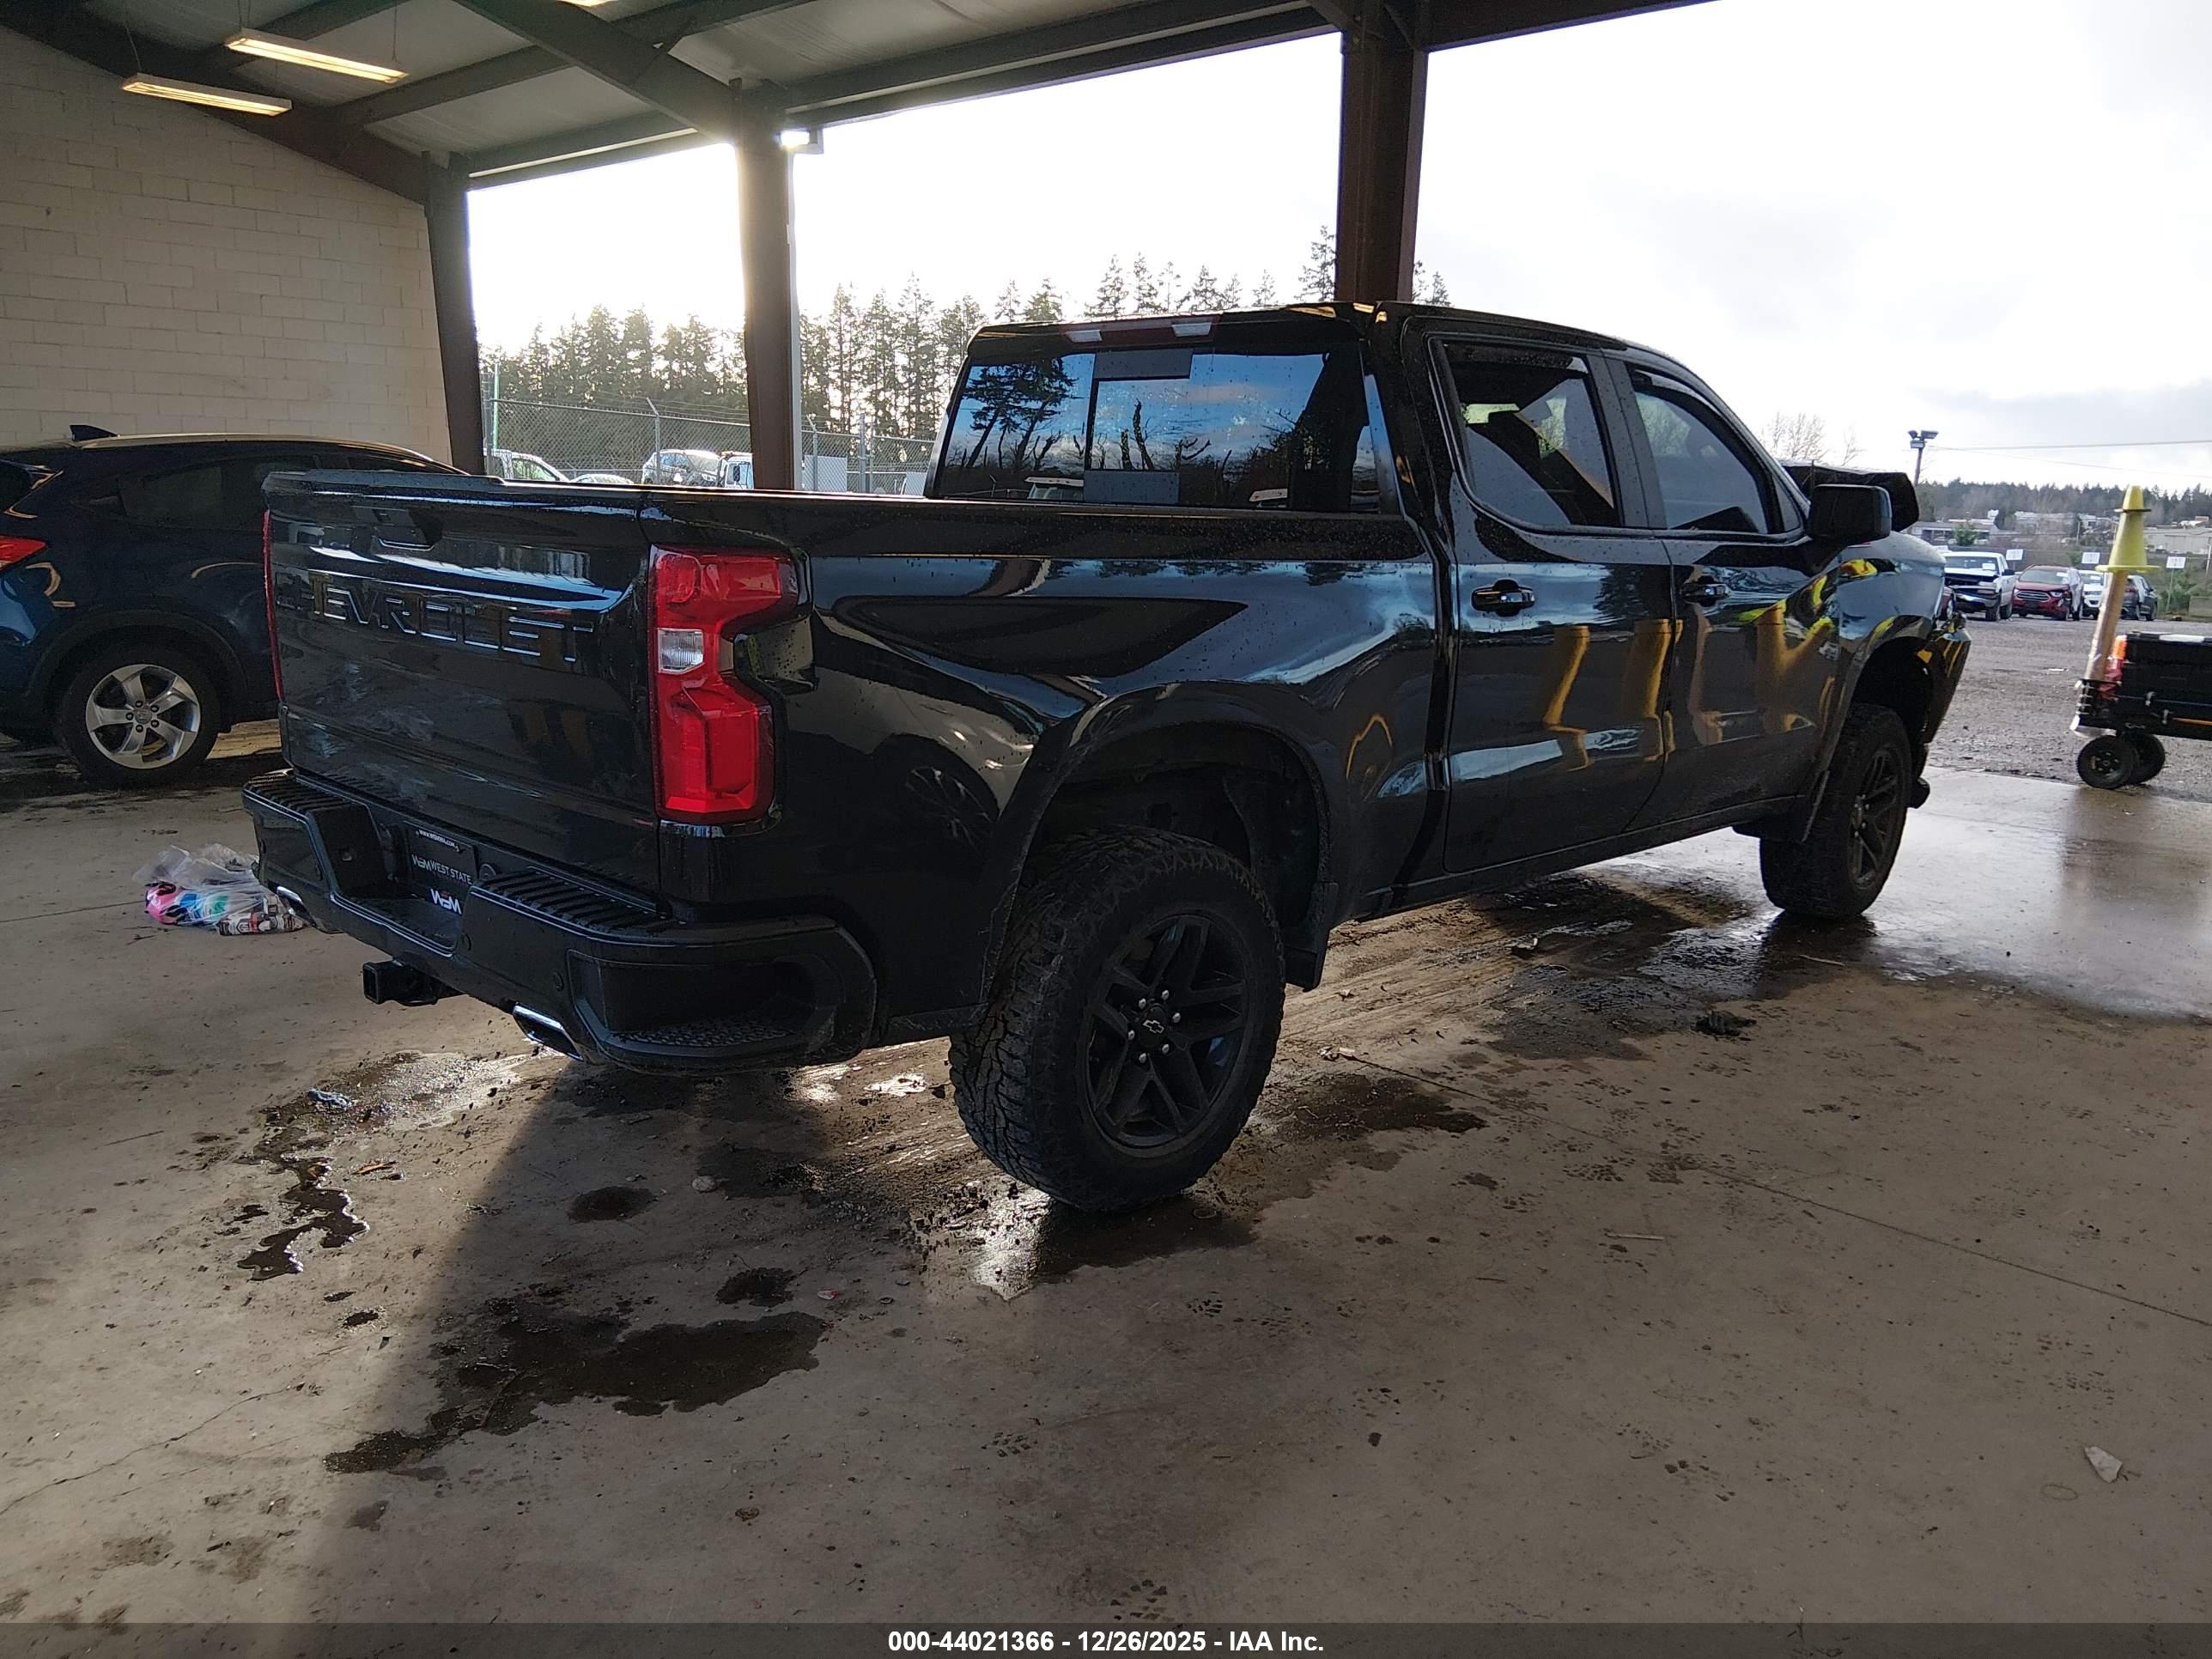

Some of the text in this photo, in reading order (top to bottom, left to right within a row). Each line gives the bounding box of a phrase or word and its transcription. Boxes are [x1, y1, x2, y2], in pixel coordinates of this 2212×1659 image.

[274, 570, 595, 665] CHEVROLET
[430, 860, 450, 877] WEST
[450, 868, 473, 885] STATE
